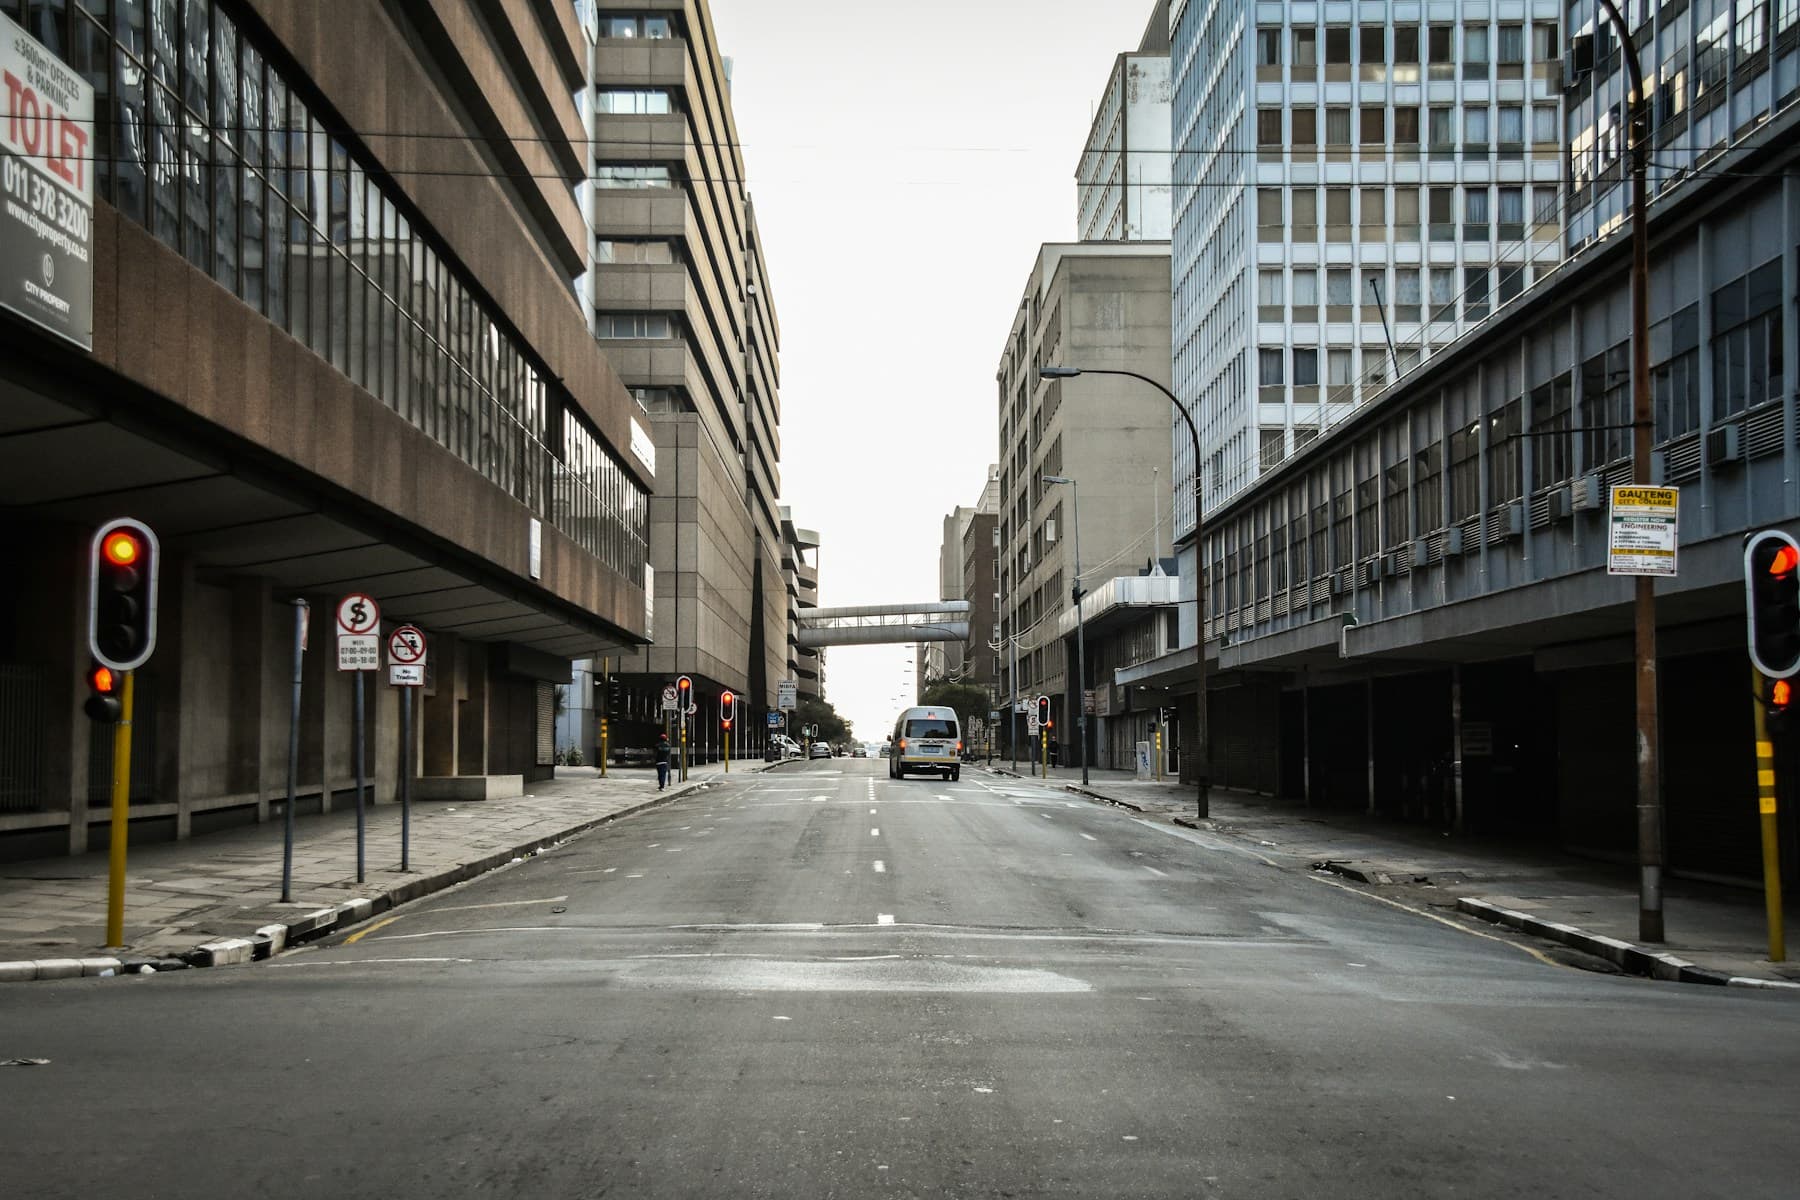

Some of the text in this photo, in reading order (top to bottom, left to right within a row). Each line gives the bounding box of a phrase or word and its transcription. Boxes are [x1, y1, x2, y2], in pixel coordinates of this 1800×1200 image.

[27, 64, 69, 112] & PARKING
[50, 63, 79, 101] OFFICES
[4, 69, 88, 192] TO LET
[4, 155, 88, 242] 011 378 3200
[7, 199, 88, 262] www.cityproperty.co.za
[25, 280, 40, 297] CITY
[39, 288, 70, 314] PROPERTY
[1618, 490, 1672, 499] GAUTENG
[1621, 522, 1667, 531] ENGINEERING
